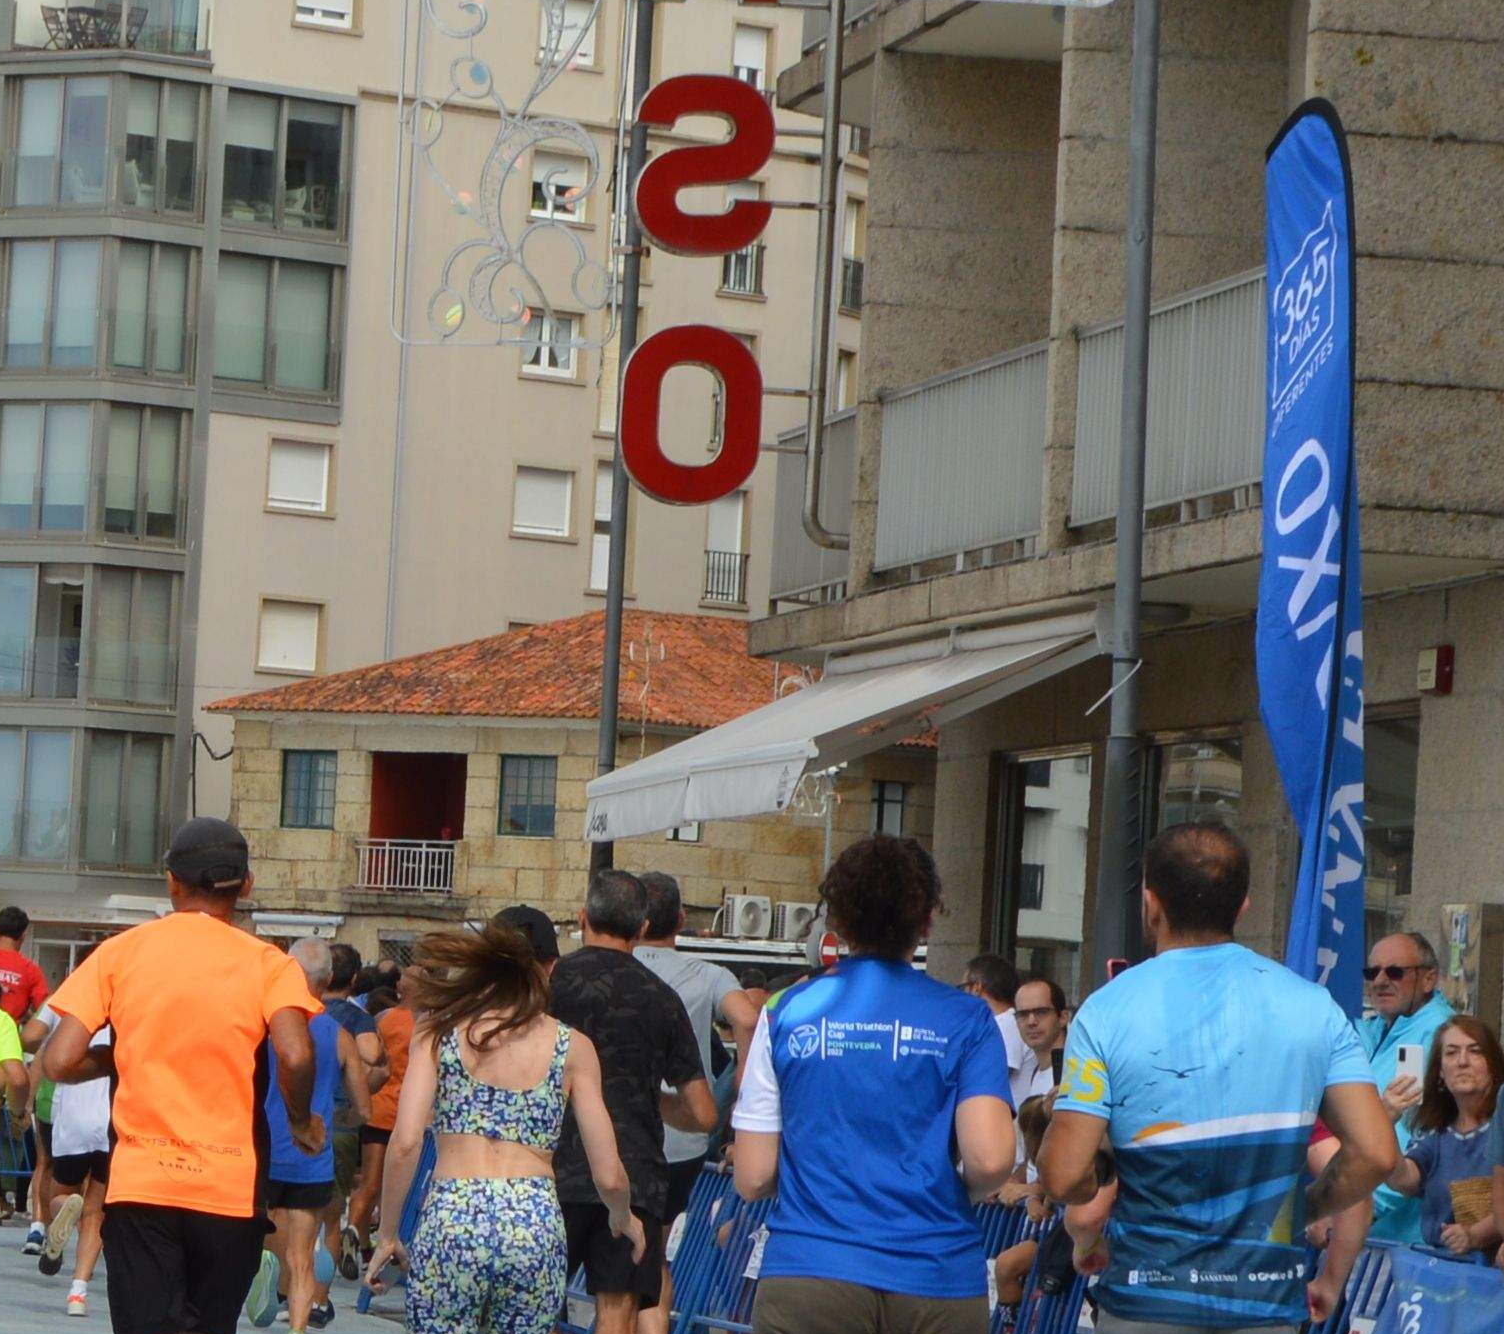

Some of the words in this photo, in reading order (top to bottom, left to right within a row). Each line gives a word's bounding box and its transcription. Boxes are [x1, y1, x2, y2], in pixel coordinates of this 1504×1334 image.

[1280, 238, 1330, 346] 365
[828, 1021, 854, 1031] World
[855, 1022, 893, 1032] Triathlon
[828, 1030, 845, 1040] Cup
[828, 1040, 882, 1051] PONTEVEDRA
